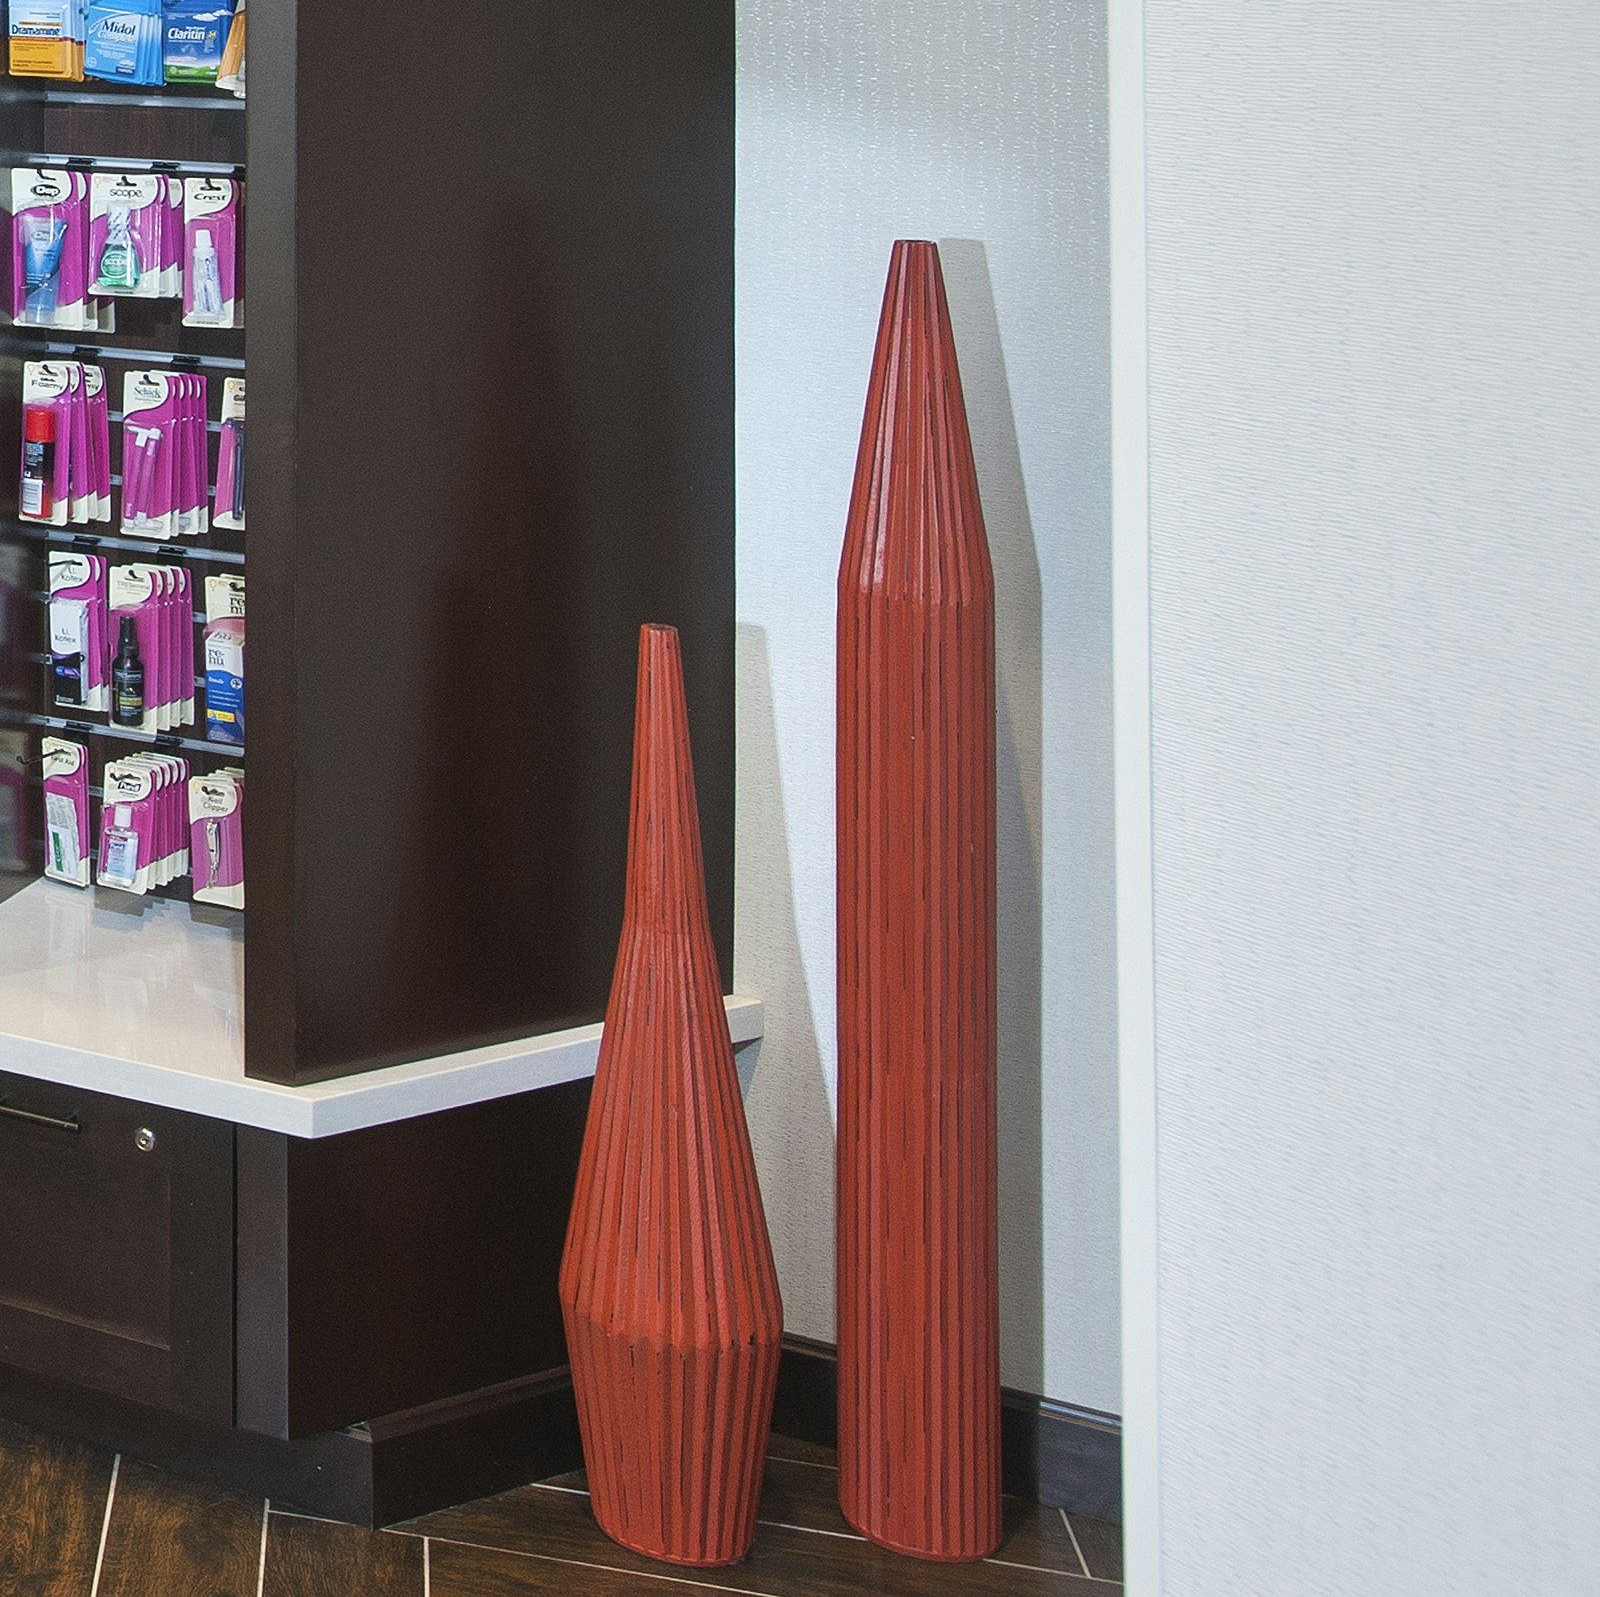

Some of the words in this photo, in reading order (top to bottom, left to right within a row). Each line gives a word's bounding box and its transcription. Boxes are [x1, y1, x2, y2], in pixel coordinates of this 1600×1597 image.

[11, 24, 61, 36] Dramamine
[102, 19, 137, 36] Midol
[167, 27, 205, 40] Claritin
[109, 189, 142, 199] scope
[193, 193, 227, 201] Crest
